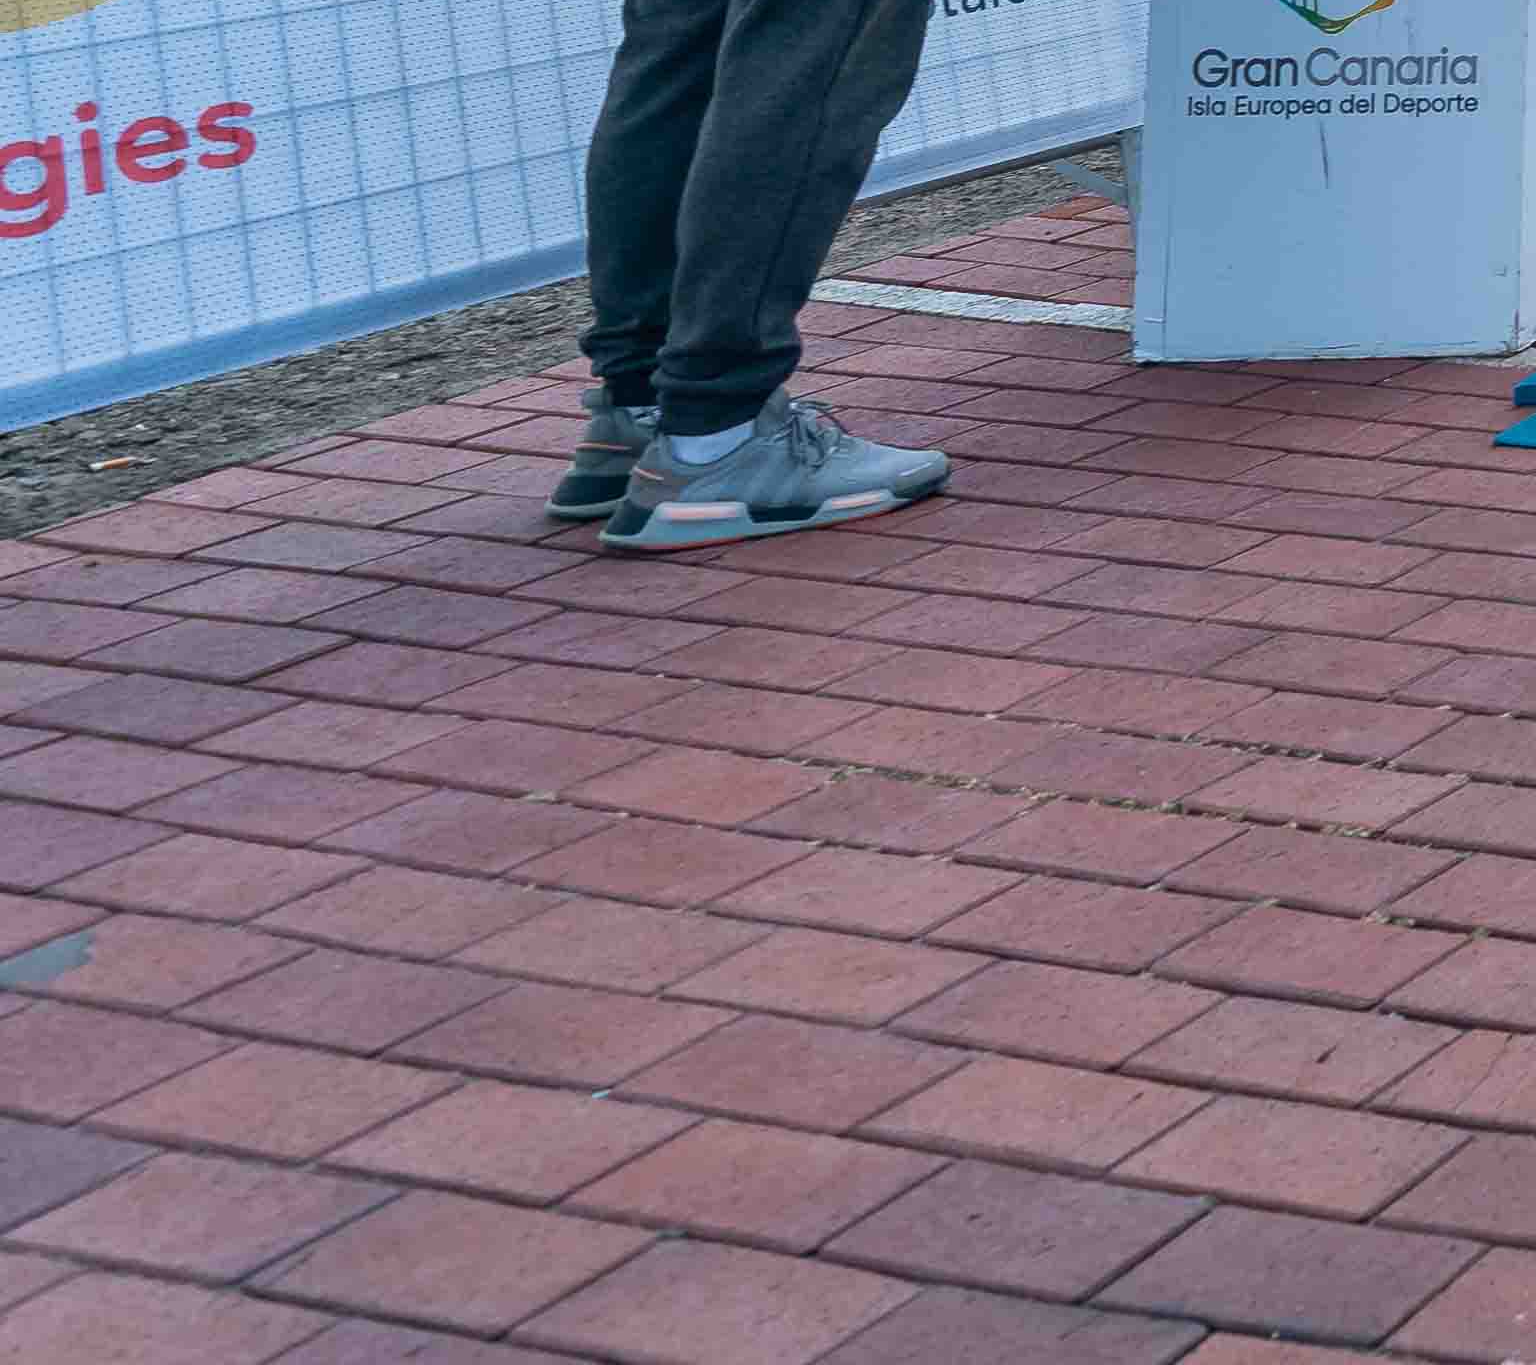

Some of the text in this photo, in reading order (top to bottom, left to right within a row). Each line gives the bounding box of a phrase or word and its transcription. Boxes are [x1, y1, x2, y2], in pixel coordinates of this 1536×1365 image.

[1193, 46, 1478, 87] Gran Canaria
[1187, 93, 1479, 119] Isla Europea del Deporte
